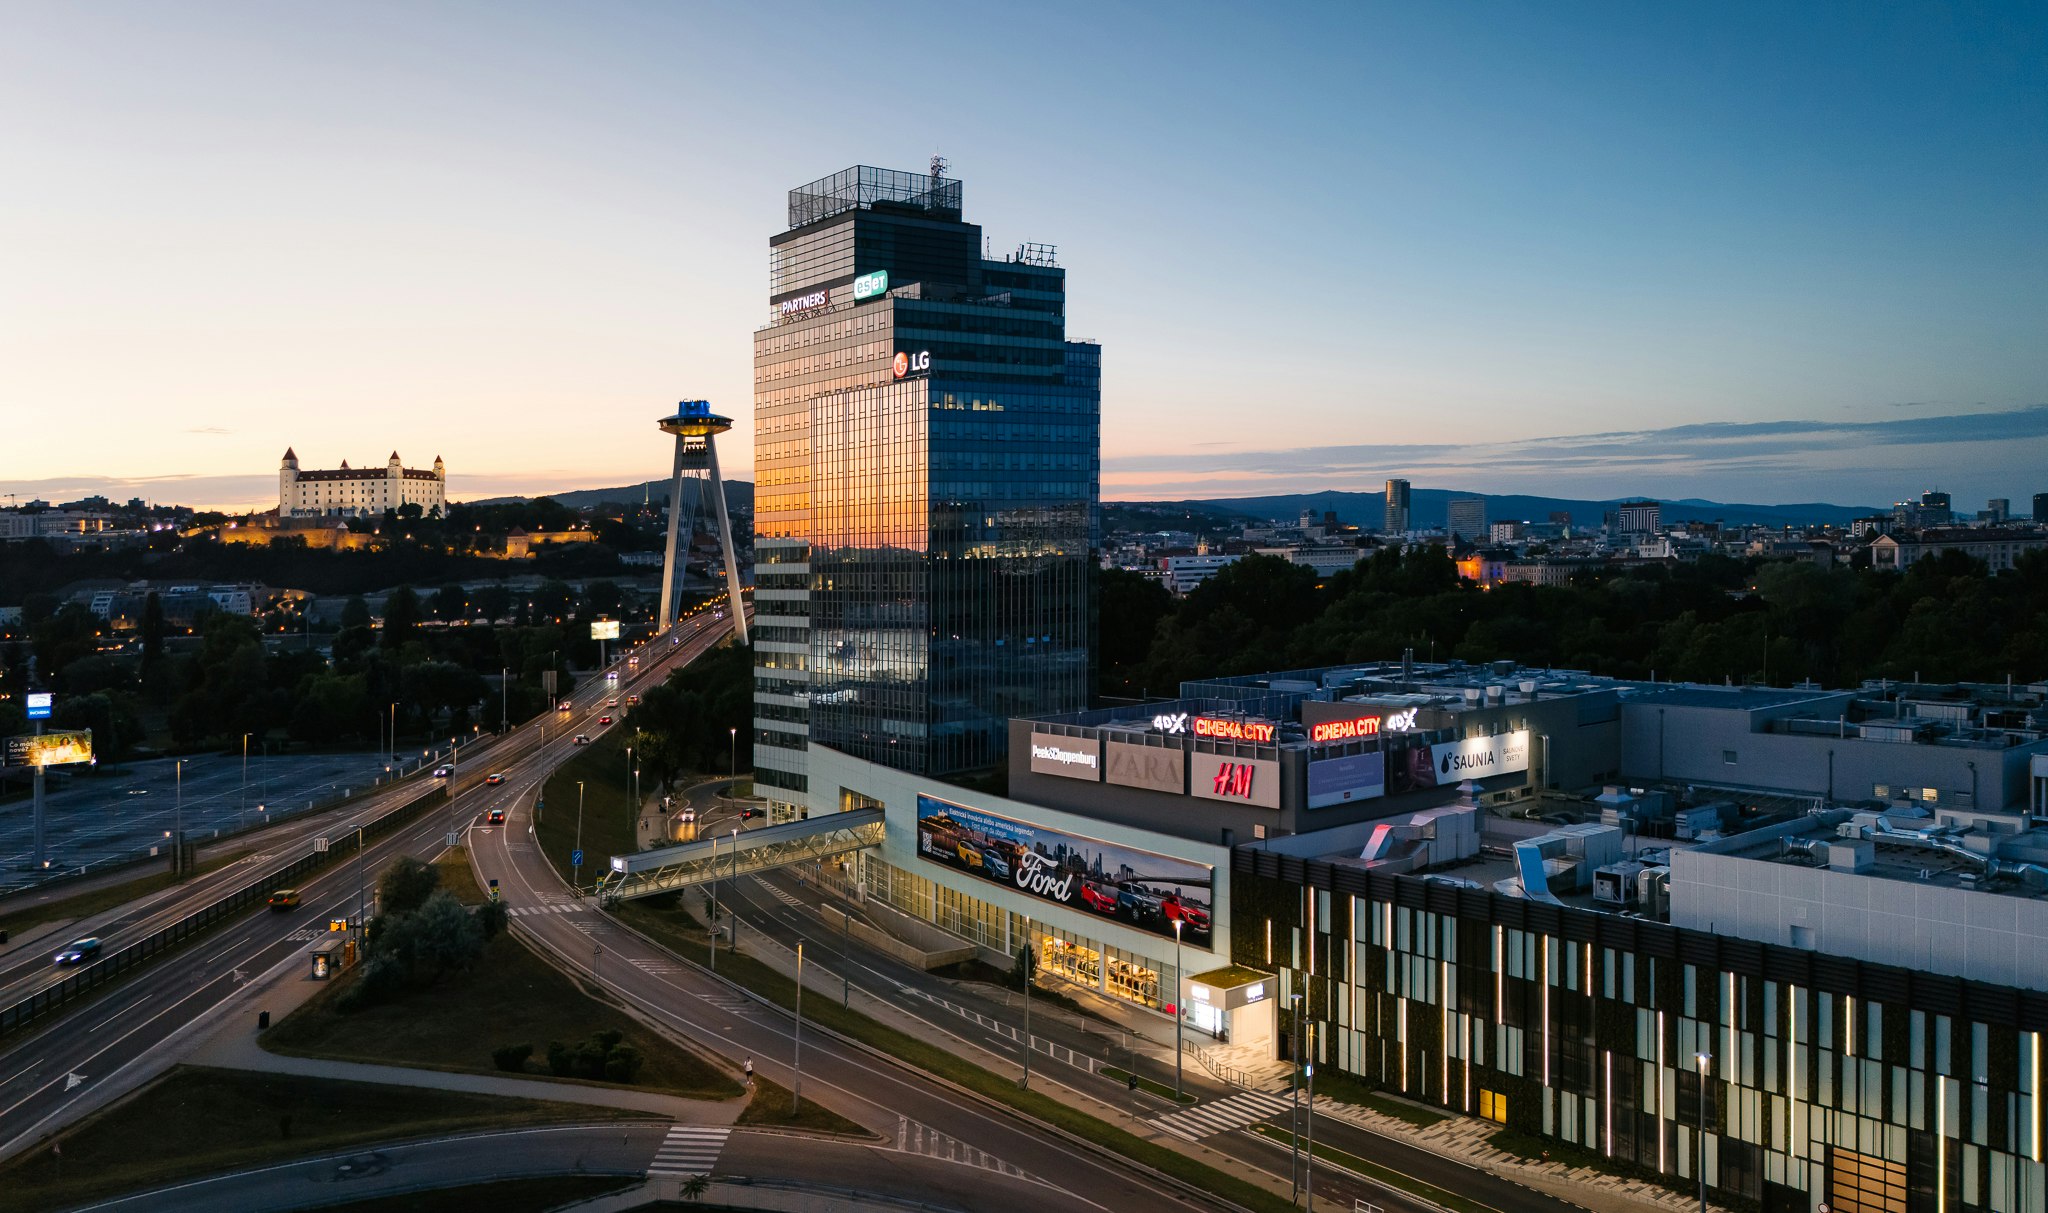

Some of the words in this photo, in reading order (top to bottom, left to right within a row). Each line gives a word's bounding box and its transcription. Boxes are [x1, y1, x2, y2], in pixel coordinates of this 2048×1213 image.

[782, 291, 826, 315] PARTNERS
[912, 351, 930, 371] LG
[1153, 713, 1187, 734] 4DX
[1195, 718, 1243, 739] CINEMA
[1244, 723, 1275, 742] CITY
[1314, 720, 1356, 742] CINEMA
[1356, 717, 1381, 736] CITY
[1387, 707, 1418, 731] 4DX
[1109, 753, 1180, 785] ZARA
[1453, 751, 1495, 770] SAUNIA
[1213, 762, 1255, 799] H&M
[1015, 851, 1073, 902] Ford
